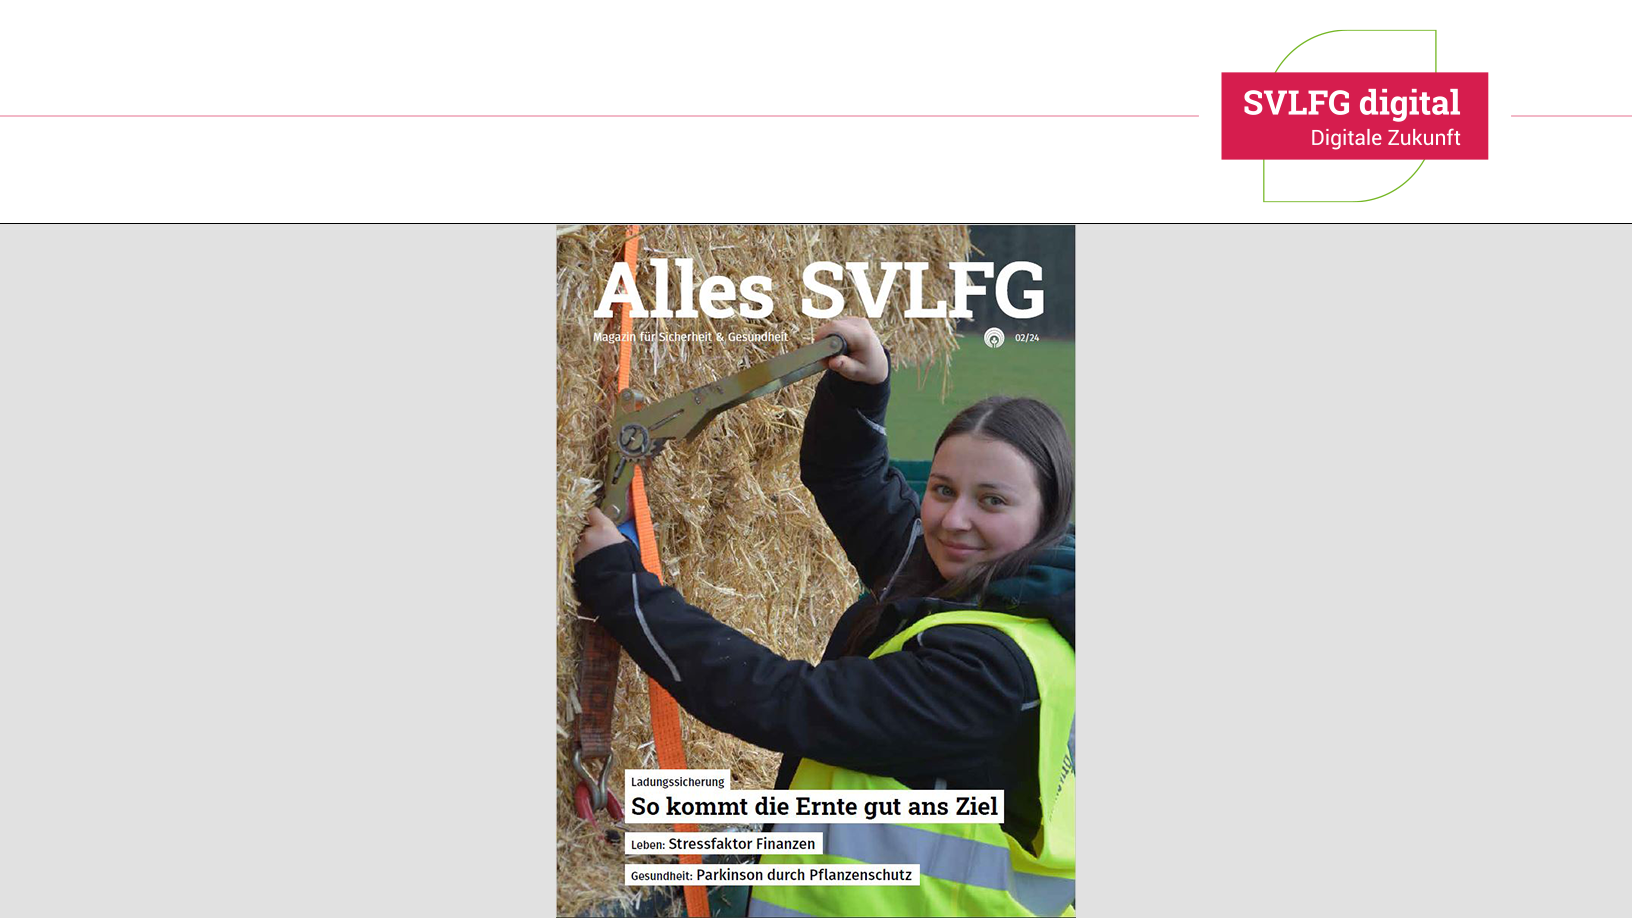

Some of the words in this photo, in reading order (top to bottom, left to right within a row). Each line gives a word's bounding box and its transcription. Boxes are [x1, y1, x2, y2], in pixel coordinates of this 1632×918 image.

[593, 258, 774, 319] Alles
[802, 260, 1045, 319] SVLFG
[593, 332, 636, 344] Magazin
[640, 332, 655, 342] für
[659, 332, 712, 342] Sicherheit
[716, 332, 725, 342] &
[728, 332, 788, 342] Gesundheit
[1015, 333, 1040, 343] 02/24
[631, 776, 725, 789] Ladungssicherung
[631, 796, 660, 816] So
[666, 796, 748, 816] kommt
[755, 796, 790, 816] die
[796, 796, 858, 816] Ernte
[864, 798, 902, 820] gut
[908, 801, 949, 816] ans
[956, 796, 999, 816] Ziel
[631, 839, 666, 850] Leben:
[668, 837, 753, 850] Stressfaktor
[756, 837, 815, 850] Finanzen
[631, 870, 693, 881] Gesundheit:
[697, 868, 763, 881] Parkinson
[767, 868, 805, 881] durch
[810, 868, 913, 882] Pflanzenschutz
